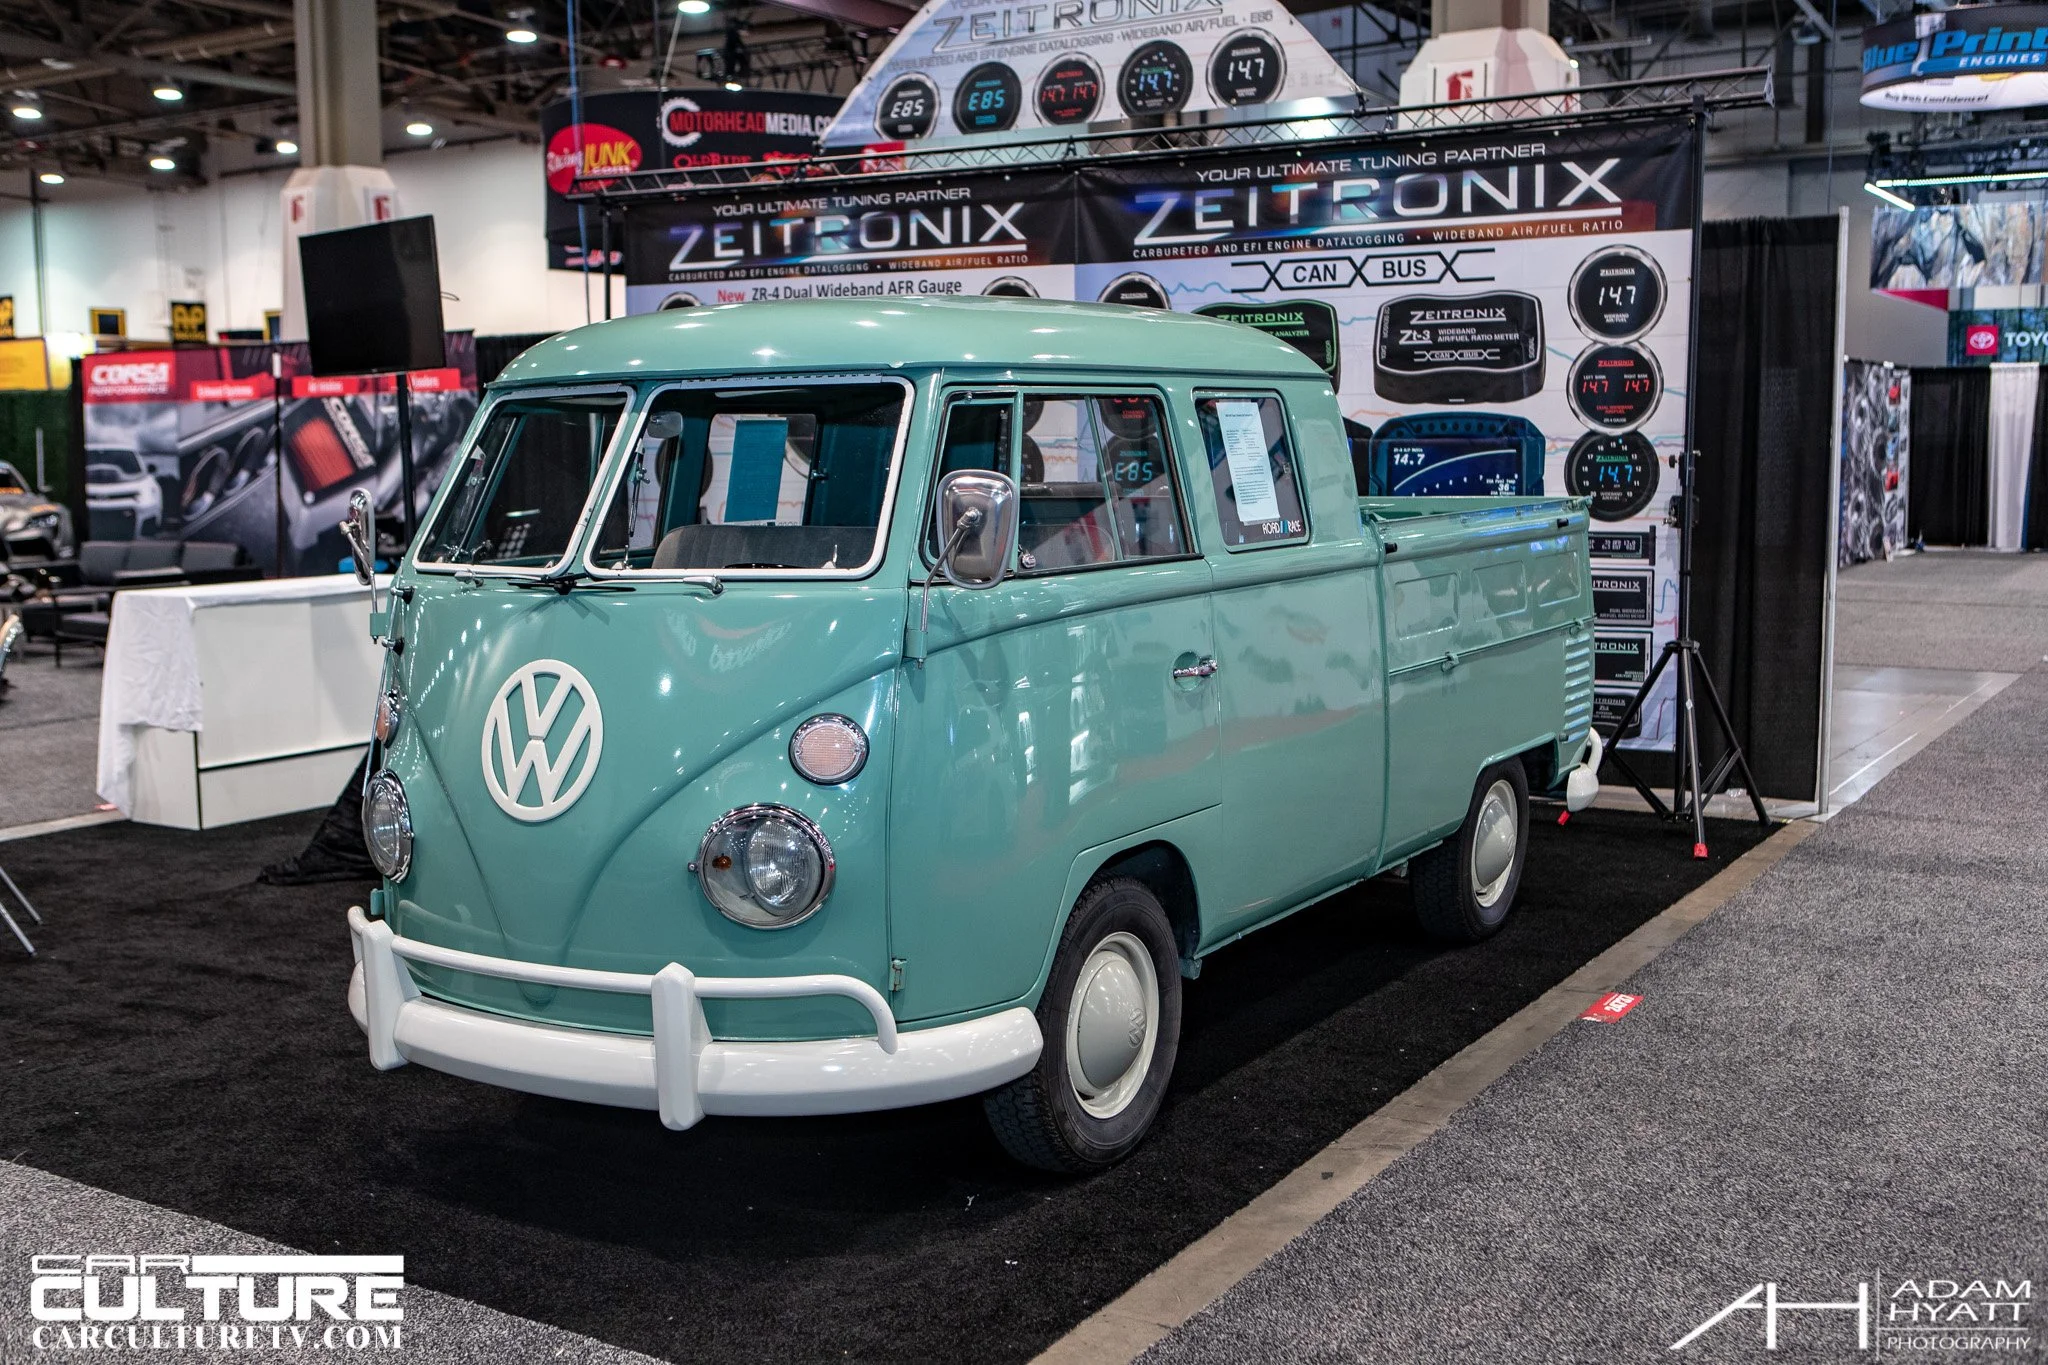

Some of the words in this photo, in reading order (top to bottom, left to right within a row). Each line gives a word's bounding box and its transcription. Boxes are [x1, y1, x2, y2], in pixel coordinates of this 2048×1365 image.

[887, 53, 951, 71] CARBURETED
[954, 51, 978, 62] AND
[994, 43, 1037, 58] ENGINE
[1039, 33, 1113, 51] DATALOGGING
[1122, 21, 1183, 41] WIDEBAND
[1185, 16, 1239, 32] AIR/FUEL
[1959, 52, 2042, 69] ENGINES
[890, 98, 925, 120] E85
[968, 89, 1006, 112] E85
[583, 139, 636, 176] JUNK
[1196, 168, 1250, 183] YOUR
[1257, 159, 1352, 179] ULTIMATE
[1358, 151, 1437, 171] TUNING
[1445, 143, 1546, 164] PARTNER
[712, 204, 754, 217] YOUR
[757, 197, 828, 214] ULTIMATE
[832, 193, 891, 208] TUNING
[895, 187, 972, 204] PARTNER
[1133, 158, 1623, 247] ZEITRONIX
[669, 202, 1028, 271] ZEITRONIX
[1133, 246, 1209, 259] CARBURETED
[1214, 244, 1238, 255] AND
[1243, 242, 1262, 252] EFI
[1267, 239, 1312, 251] ENGINE
[1317, 233, 1405, 249] DATALOGGING
[1433, 227, 1504, 242] WIDEBAND
[1511, 224, 1575, 237] AIR/FUEL
[1582, 220, 1624, 232] RATIO
[669, 271, 725, 282] CARBURETED
[728, 270, 746, 279] AND
[750, 269, 764, 278] EFI
[767, 267, 801, 277] ENGINE
[804, 262, 869, 275] DATALOGGING
[889, 260, 941, 270] WIDEBAND
[945, 257, 993, 267] AIR/FUEL
[997, 254, 1028, 264] RATIO
[1292, 263, 1337, 283] CAN
[1382, 260, 1427, 279] BUS
[717, 289, 746, 302] New
[752, 287, 780, 301] ZR-4
[784, 284, 813, 299] Dual
[816, 281, 884, 298] Wideband
[888, 280, 914, 295] AFR
[918, 279, 962, 296] Gauge
[1598, 285, 1637, 306] 14.7
[1410, 307, 1507, 325] ZEITRONIX
[1275, 329, 1310, 338] ANALYZER
[1399, 329, 1432, 345] Zt-3
[1437, 328, 1477, 336] WIDEBAND
[1437, 334, 1470, 343] AIR/FUEL
[1471, 333, 1493, 342] RATIO
[1494, 332, 1520, 341] METER
[91, 362, 170, 386] CORSA
[1393, 453, 1425, 466] 14.7
[1114, 462, 1153, 483] E85
[1287, 520, 1302, 534] RACE
